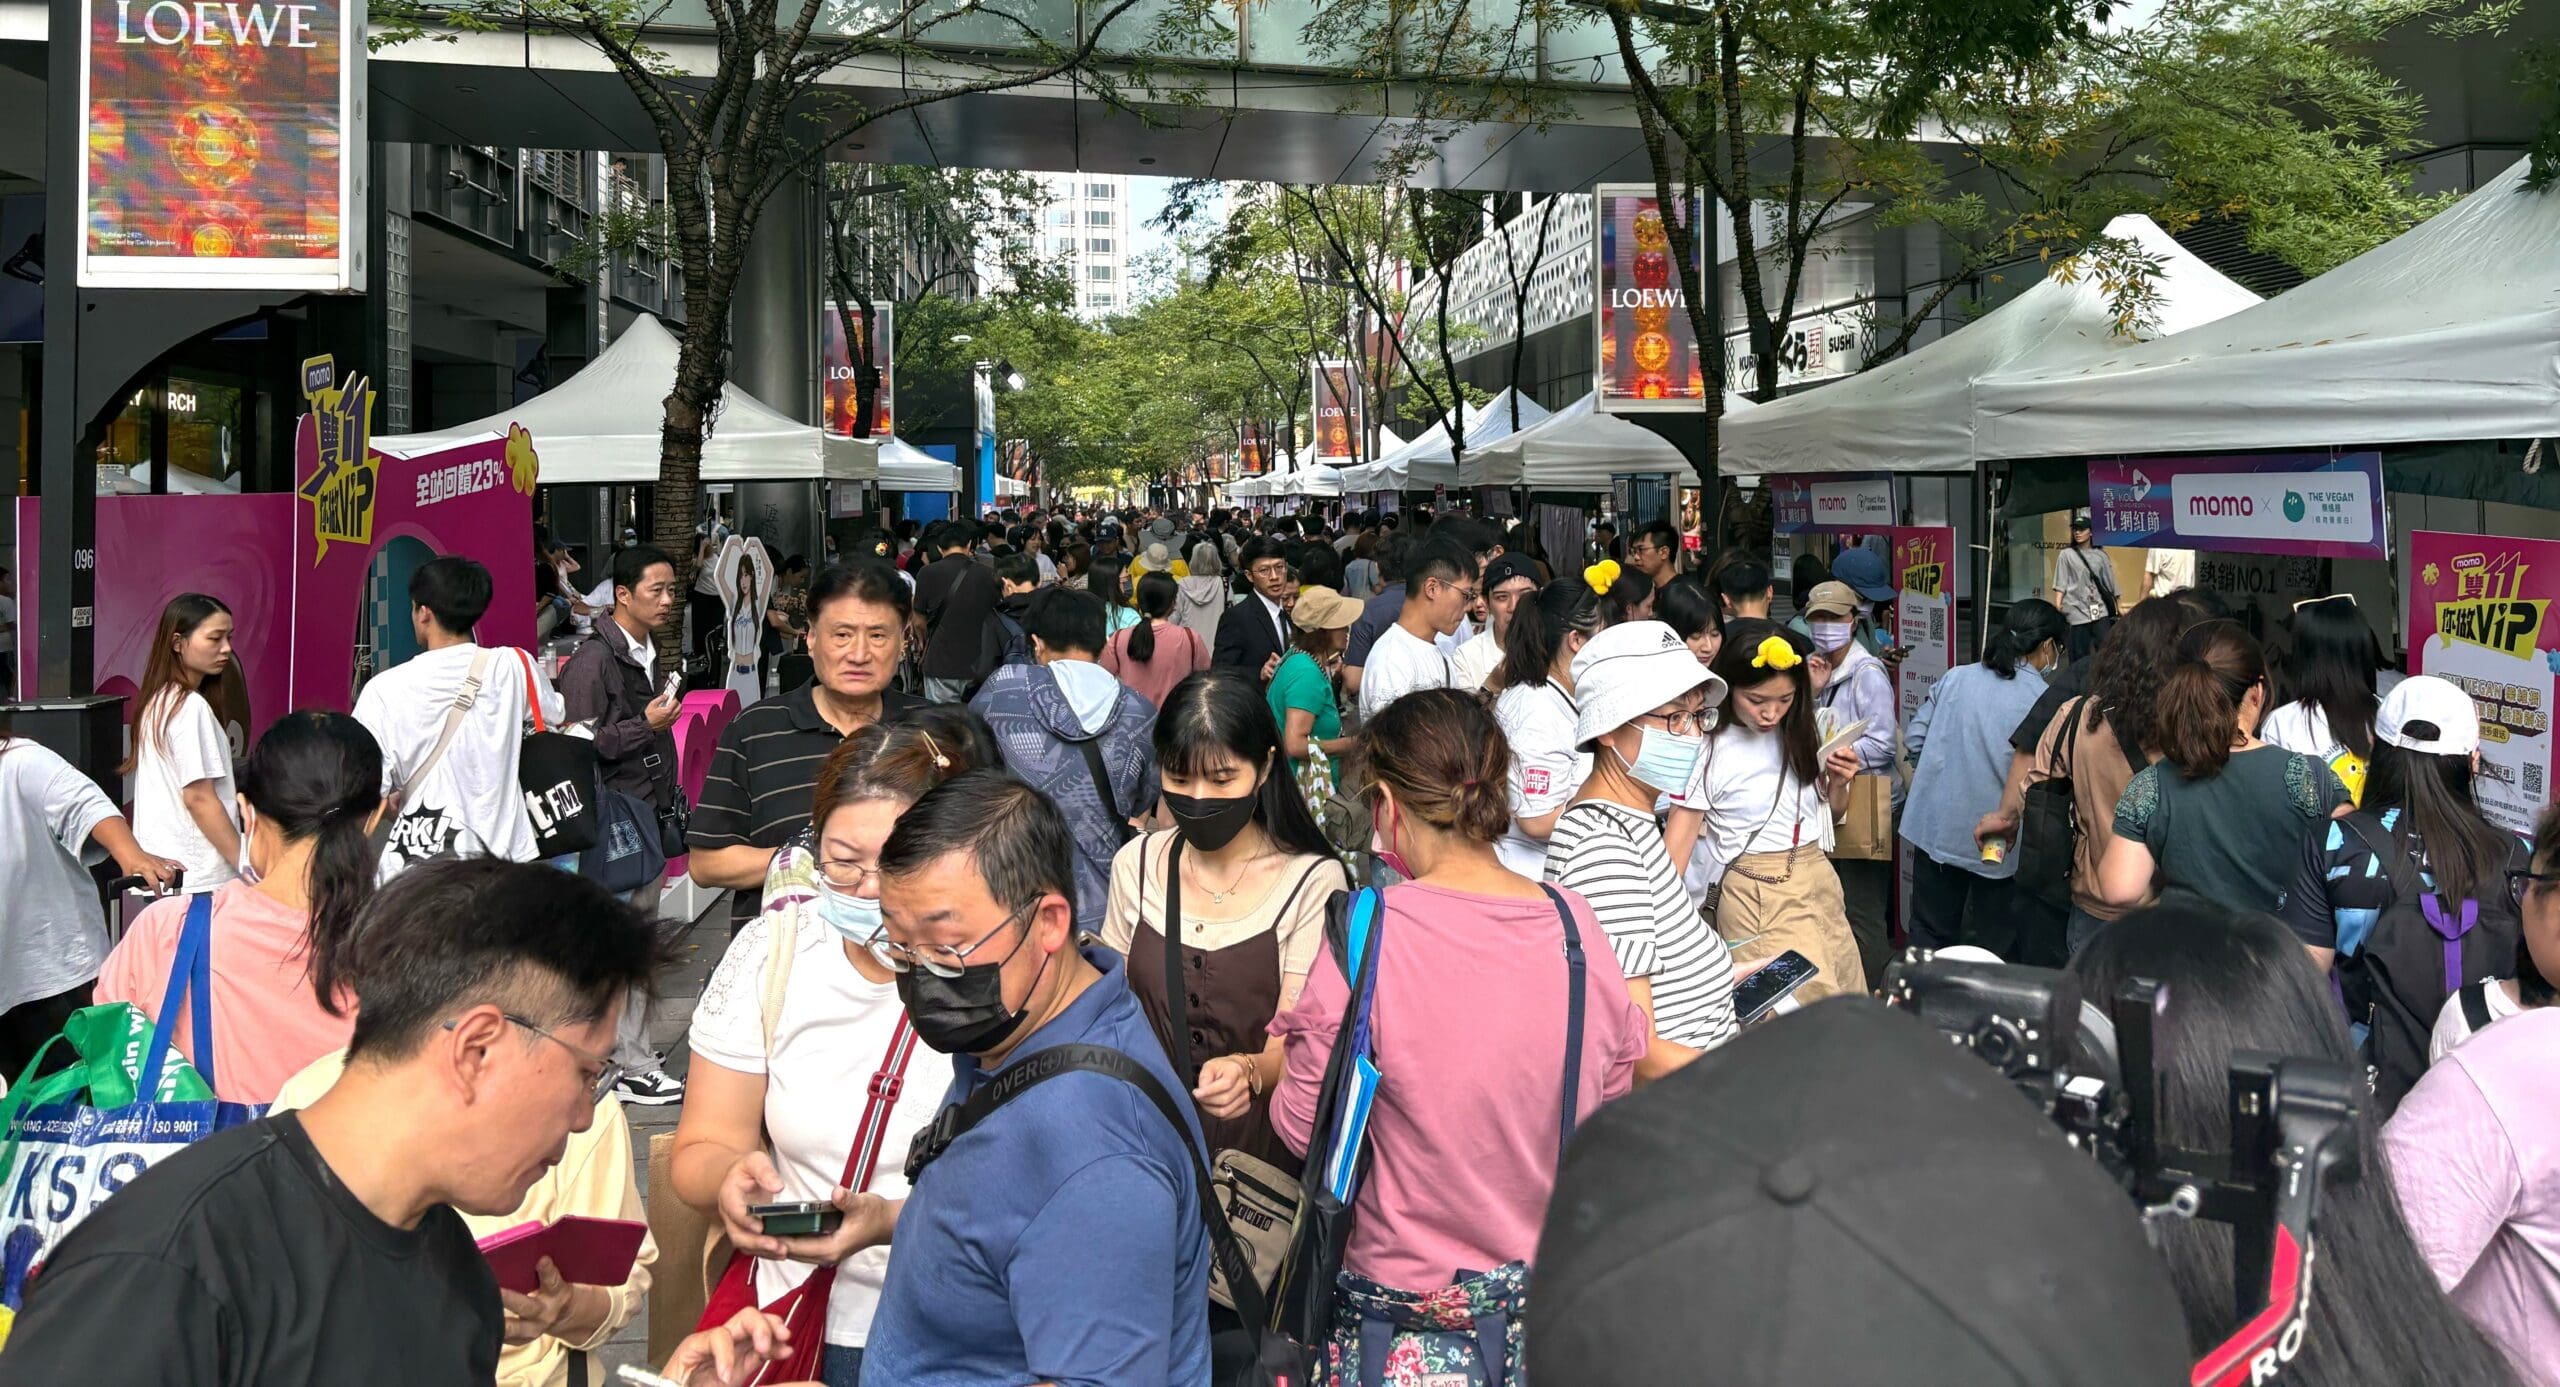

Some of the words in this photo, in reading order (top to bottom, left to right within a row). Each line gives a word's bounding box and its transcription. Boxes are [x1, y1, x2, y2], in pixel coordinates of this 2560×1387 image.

[115, 0, 318, 48] LOEWE
[1828, 333, 1855, 353] SUSHI
[309, 365, 331, 388] momo
[830, 366, 884, 380] LOE
[167, 392, 196, 412] RCH
[1819, 497, 1847, 511] momo
[2190, 496, 2253, 516] momo
[2308, 492, 2323, 501] THE
[2325, 492, 2354, 502] VEGAN
[74, 549, 94, 570] 096
[2456, 557, 2480, 568] momo
[2200, 561, 2278, 594] 熱銷NO.1
[993, 1059, 1039, 1101] OVER
[152, 1120, 171, 1133] ISO
[173, 1120, 198, 1133] 9001
